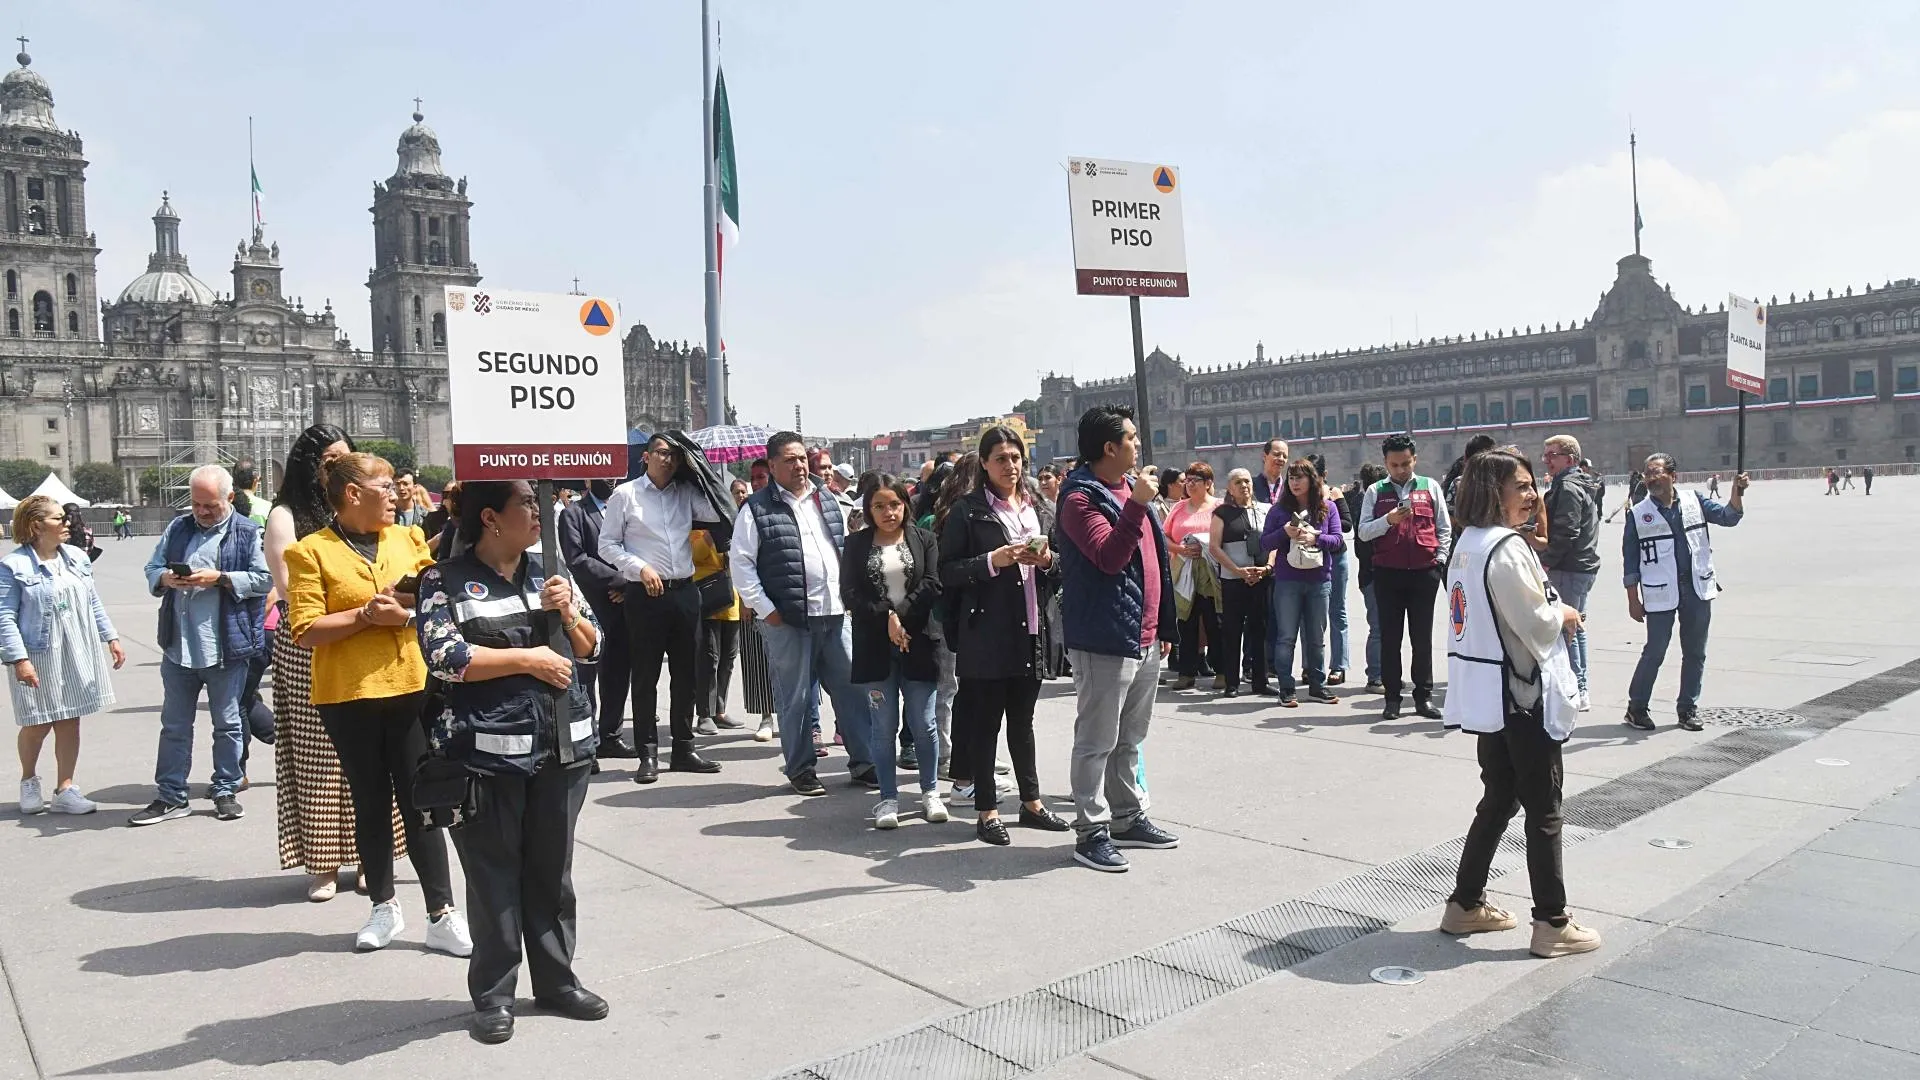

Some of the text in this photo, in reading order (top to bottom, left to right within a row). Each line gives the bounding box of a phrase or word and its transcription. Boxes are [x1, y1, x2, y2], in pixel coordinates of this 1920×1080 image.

[1092, 199, 1161, 221] PRIMER
[1110, 227, 1153, 247] PISO
[1093, 276, 1178, 288] PUNTO DE REUNIÓN
[1730, 332, 1762, 351] PLANTA BAJA
[477, 350, 599, 376] SEGUNDO
[510, 385, 575, 410] PISO
[479, 451, 612, 467] PUNTO DE REUNIÓN
